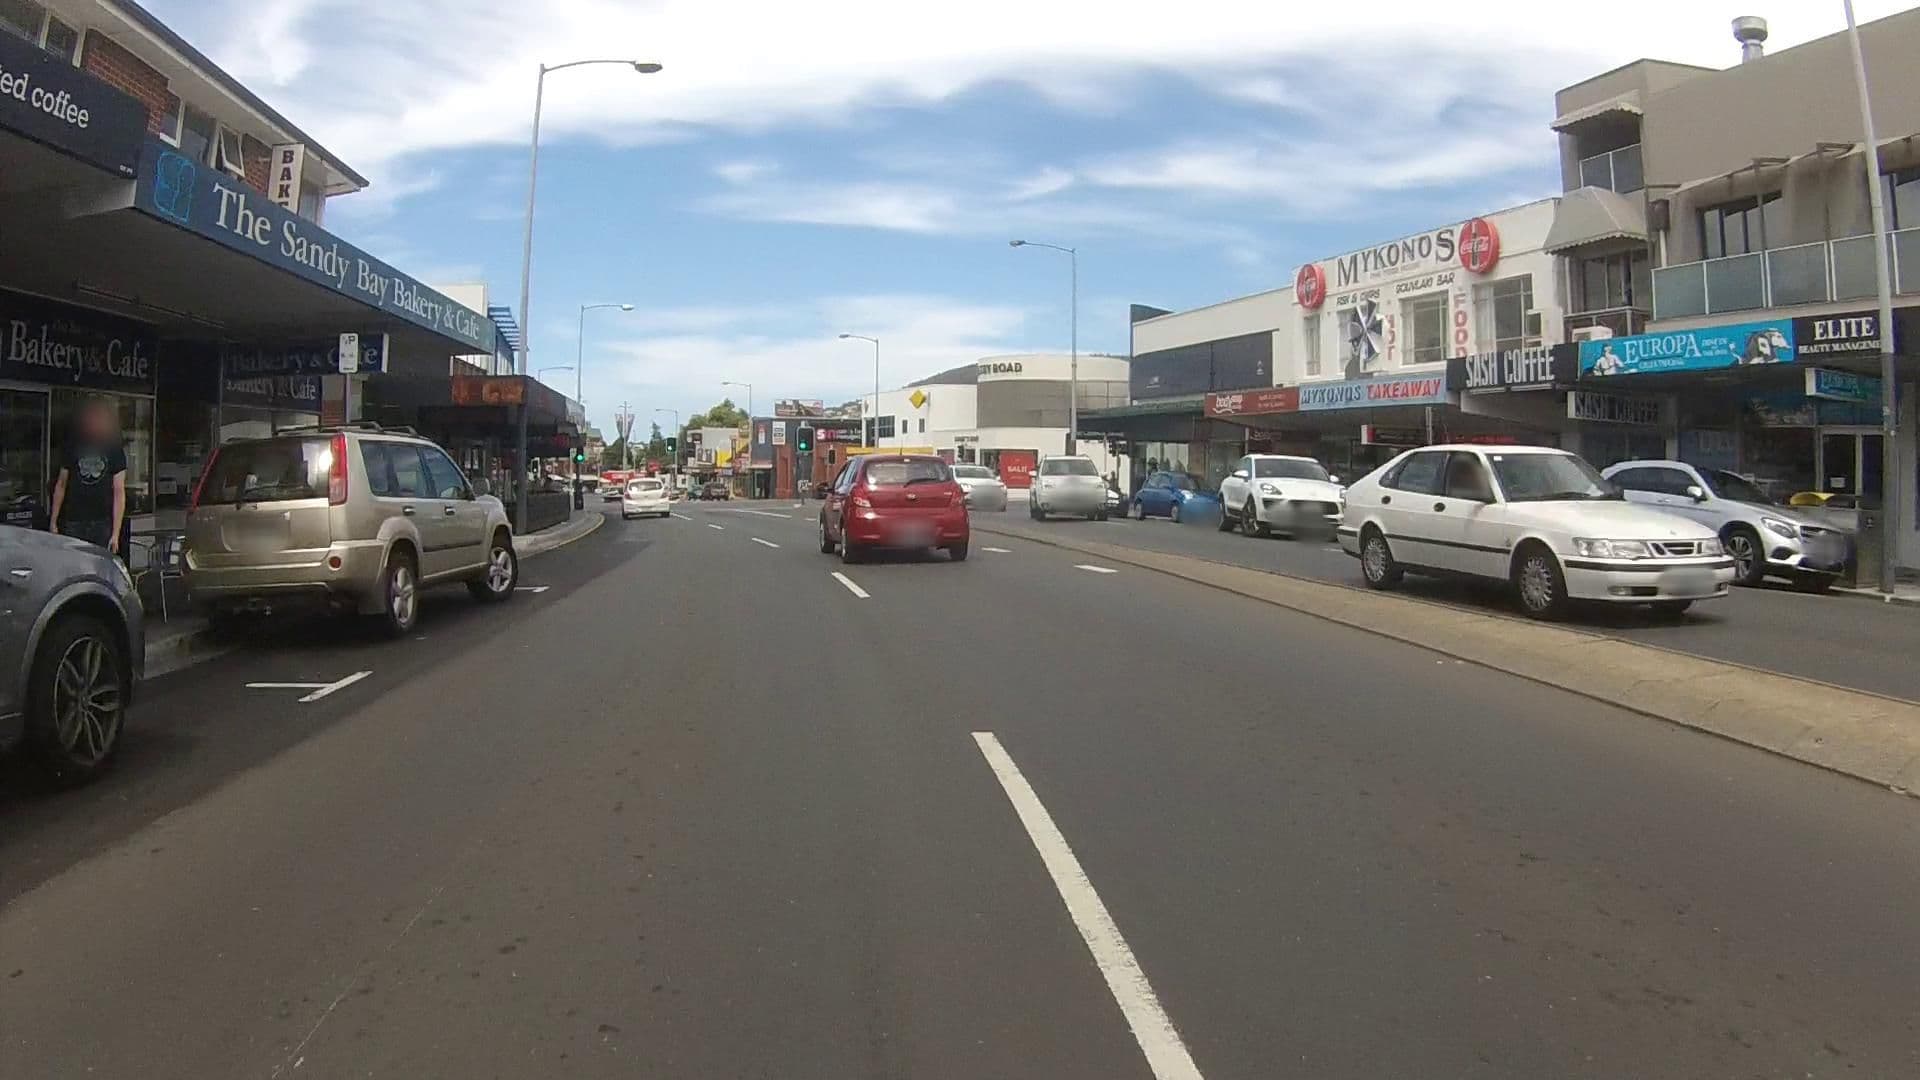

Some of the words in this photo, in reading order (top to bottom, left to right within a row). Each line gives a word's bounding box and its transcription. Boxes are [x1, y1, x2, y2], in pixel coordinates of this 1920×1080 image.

[31, 90, 89, 128] coffee
[213, 182, 271, 245] The
[281, 219, 350, 289] Sandy
[356, 259, 389, 305] Bay
[393, 277, 442, 329] Bakery
[443, 303, 456, 329] &
[456, 309, 480, 340] Cafe
[1336, 228, 1455, 288] MYKONOS
[1396, 278, 1434, 294] SOUVLAKI
[1436, 272, 1455, 286] BAR
[1813, 316, 1875, 341] ELITE
[8, 320, 83, 382] Bakery
[107, 338, 148, 379] Cafe
[1623, 333, 1702, 365] EUROPA
[1798, 344, 1830, 354] BEAUTY
[1831, 339, 1881, 352] MANAGEME
[992, 362, 1022, 374] ROAD
[1465, 350, 1498, 387] SASH
[1503, 347, 1555, 384] COFFEE
[1301, 385, 1362, 405] MYKONOS
[1366, 378, 1442, 400] TAKEAWAY
[1575, 391, 1608, 418] SASH
